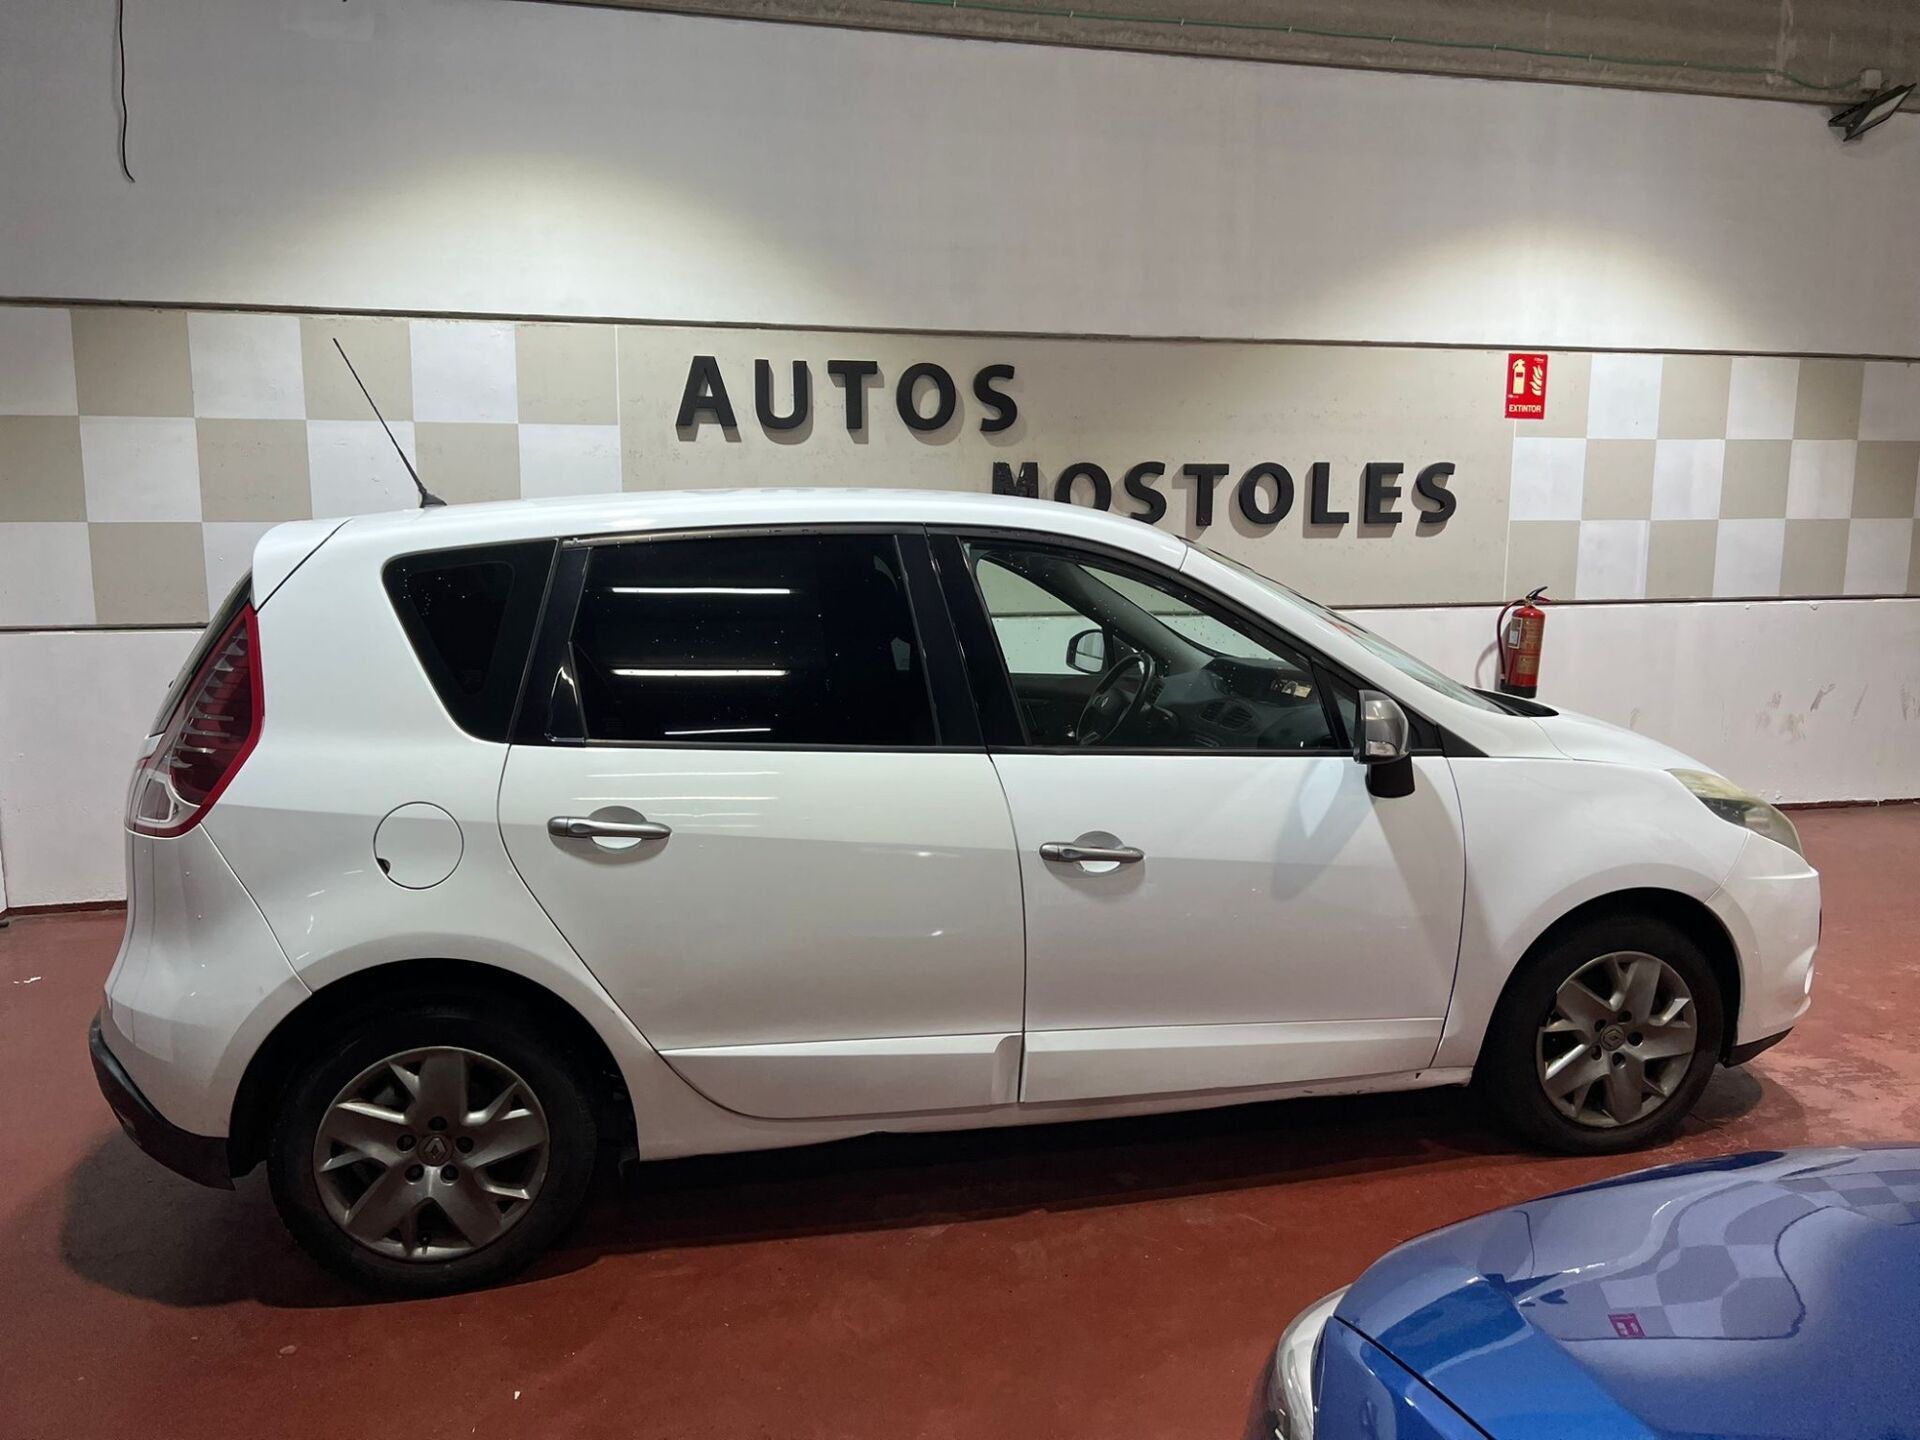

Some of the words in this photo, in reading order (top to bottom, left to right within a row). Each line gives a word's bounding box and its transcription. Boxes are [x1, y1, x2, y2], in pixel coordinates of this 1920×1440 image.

[676, 355, 1018, 432] AUTOS
[1508, 404, 1542, 413] EXTINTOR
[992, 461, 1457, 526] MOSTOLES
